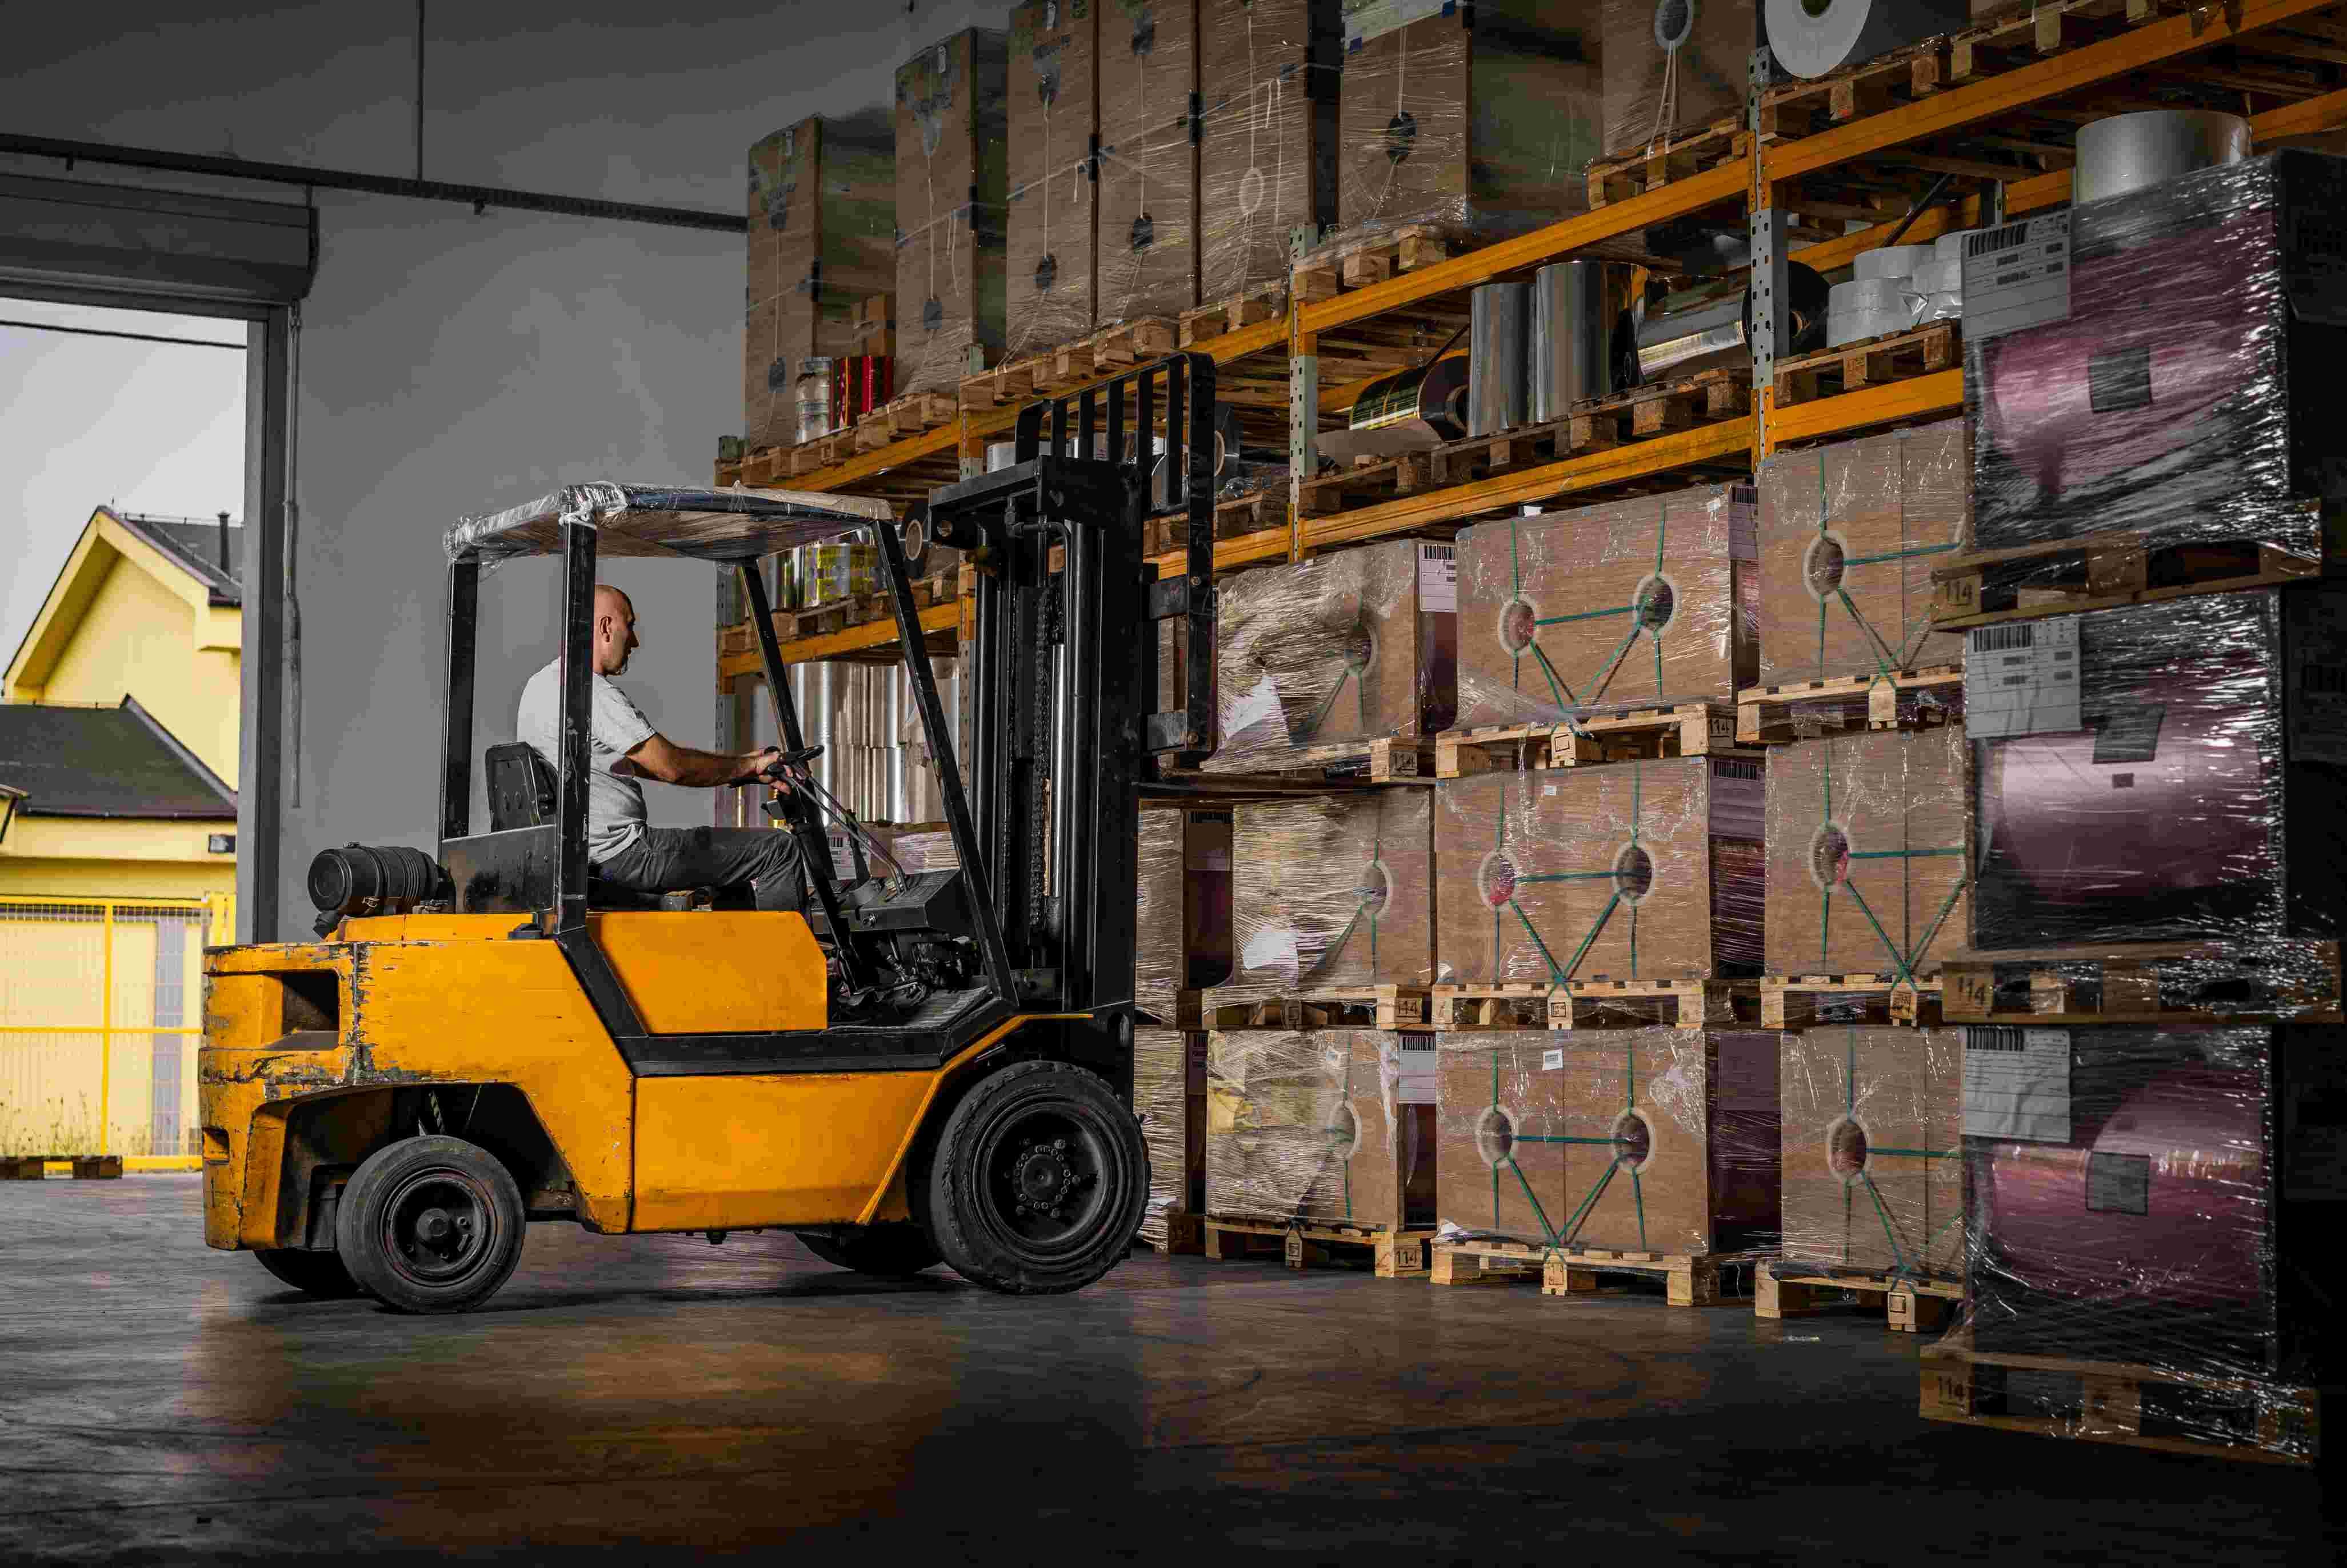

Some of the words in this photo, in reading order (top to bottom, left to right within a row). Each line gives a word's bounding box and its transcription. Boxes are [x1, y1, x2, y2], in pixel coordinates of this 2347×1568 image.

[1946, 580, 1973, 604] 114
[1957, 978, 1985, 1005] 114
[1938, 1376, 1965, 1401] 114
